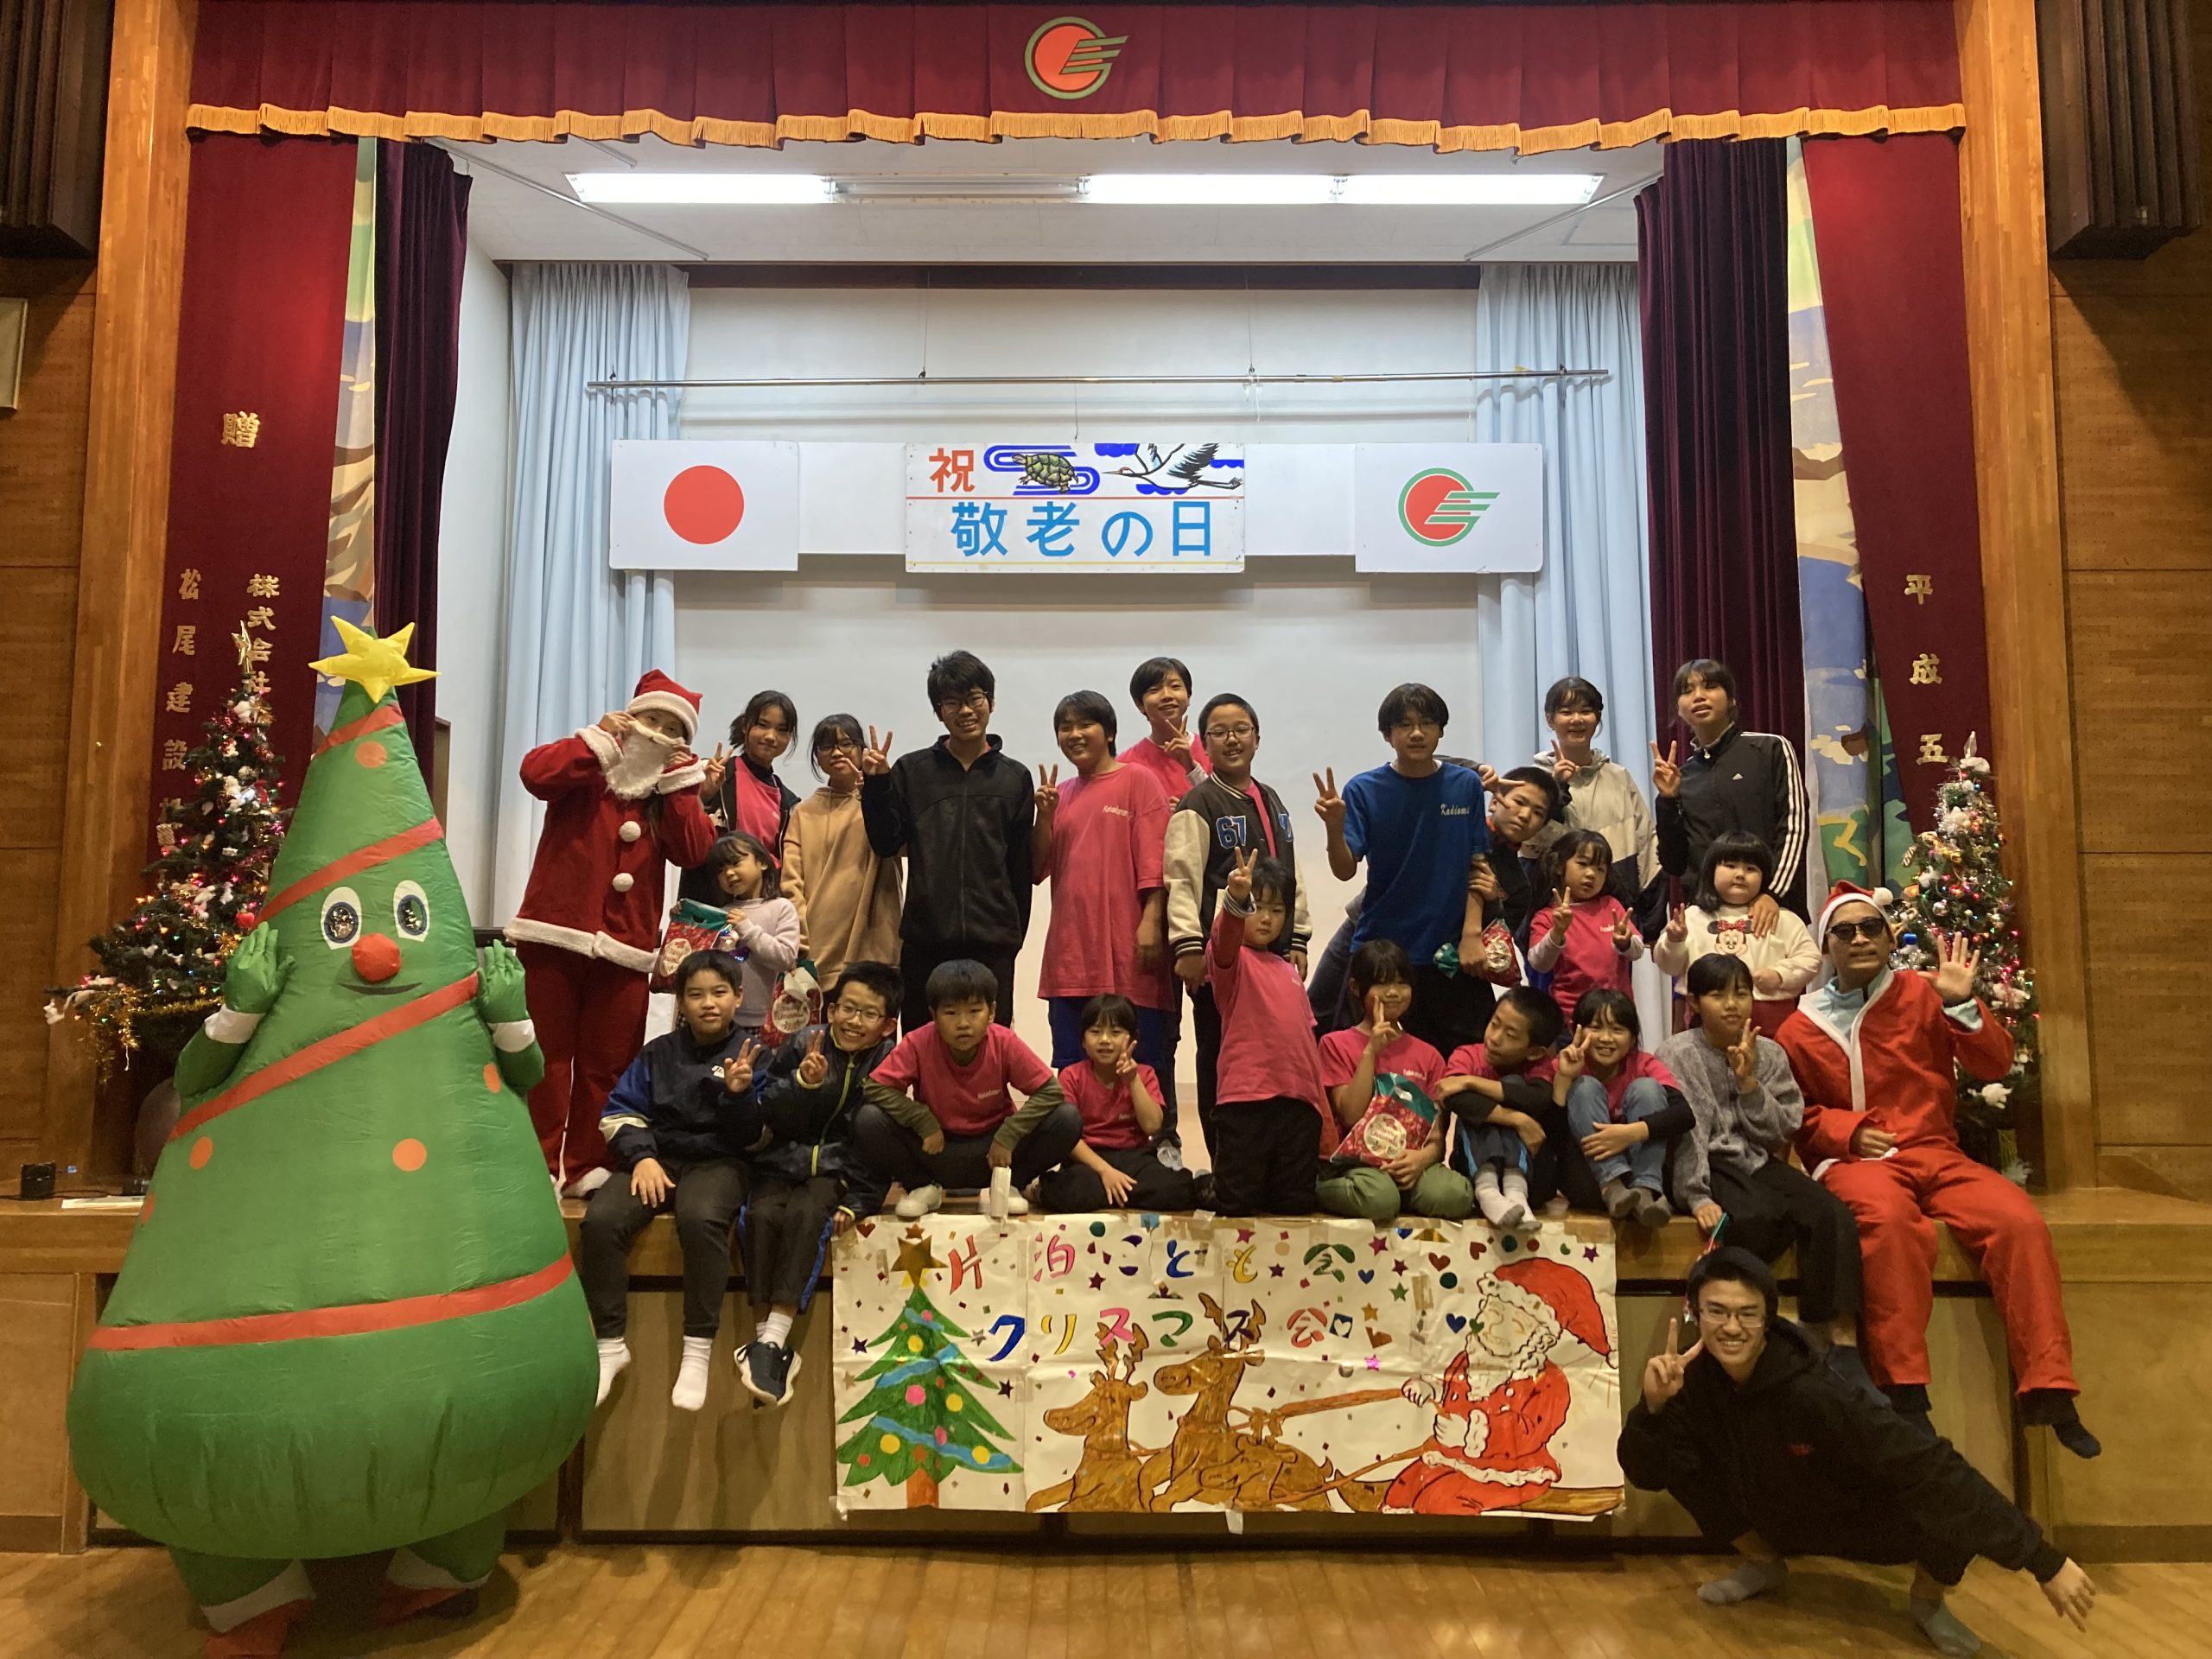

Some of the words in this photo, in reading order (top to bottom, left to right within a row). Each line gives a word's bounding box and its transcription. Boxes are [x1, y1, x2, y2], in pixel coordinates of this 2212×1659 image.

[221, 410, 260, 448] 贈
[929, 448, 976, 493] 祝
[950, 500, 1211, 557] 敬老の日
[246, 573, 280, 693] 株式会社
[1904, 574, 1950, 766] 平成五
[1216, 815, 1246, 849] 67
